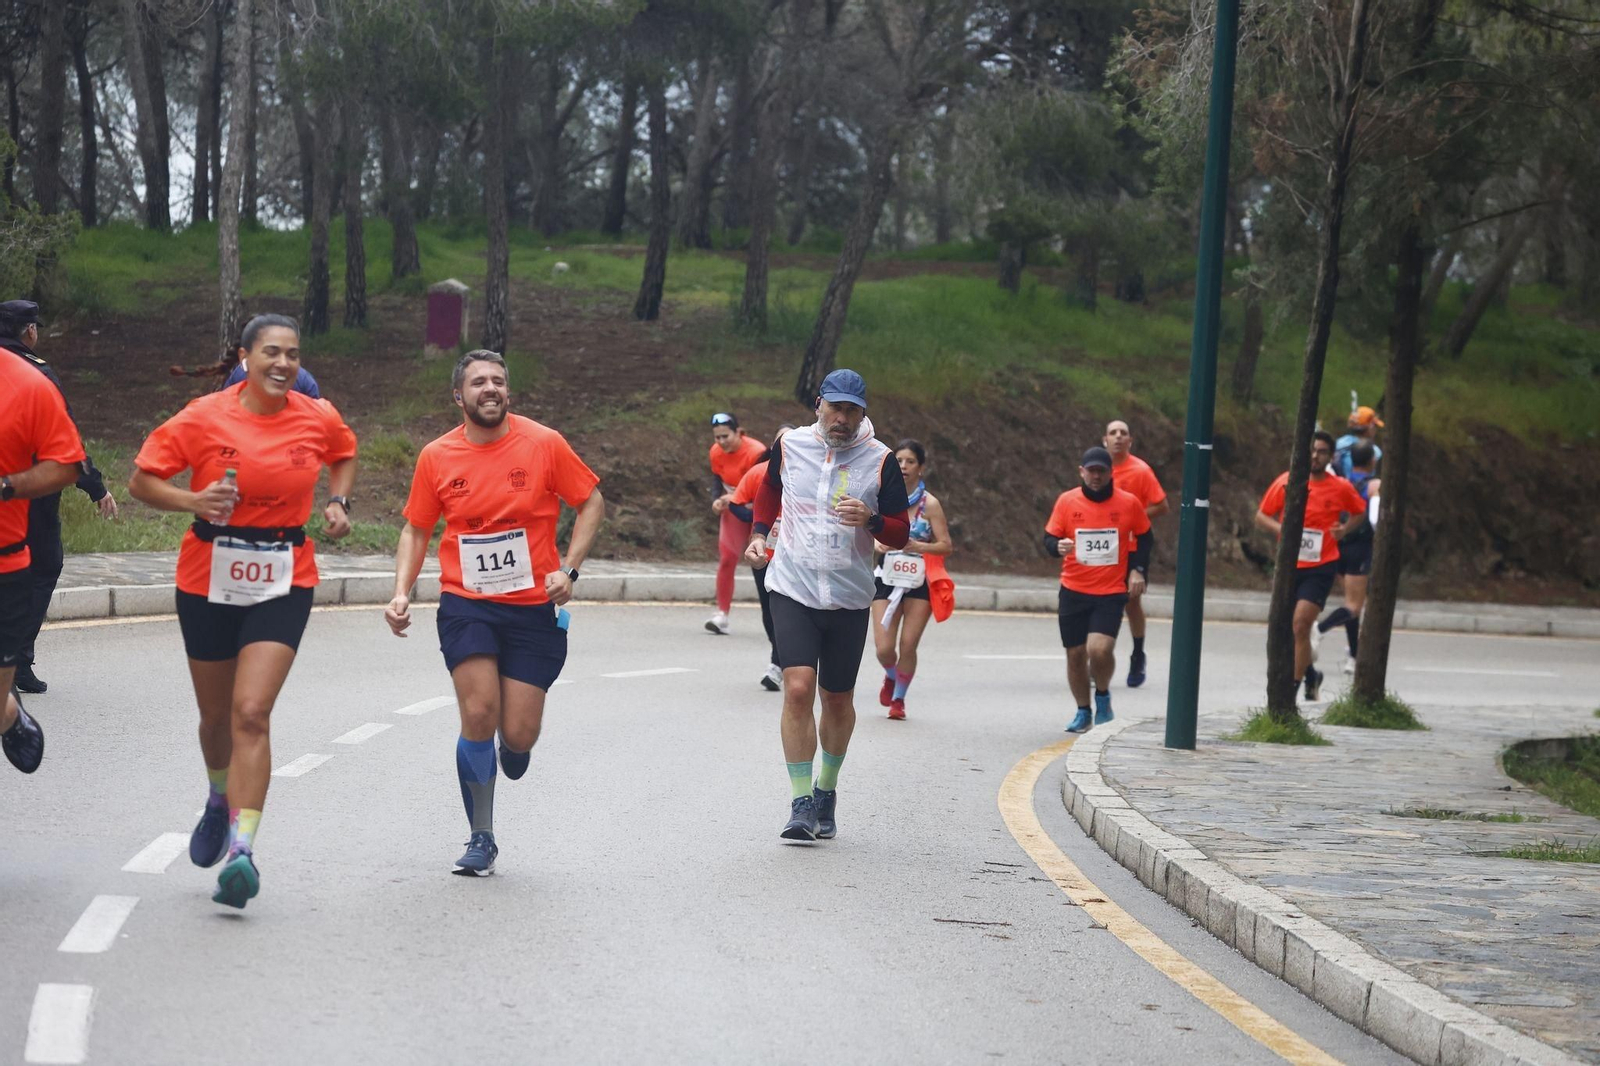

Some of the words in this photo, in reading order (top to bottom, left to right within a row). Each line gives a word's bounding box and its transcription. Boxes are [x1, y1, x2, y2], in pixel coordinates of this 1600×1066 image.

[806, 532, 840, 549] 31
[1086, 540, 1109, 551] 344
[476, 550, 516, 572] 114
[893, 561, 917, 574] 668
[230, 561, 275, 582] 601
